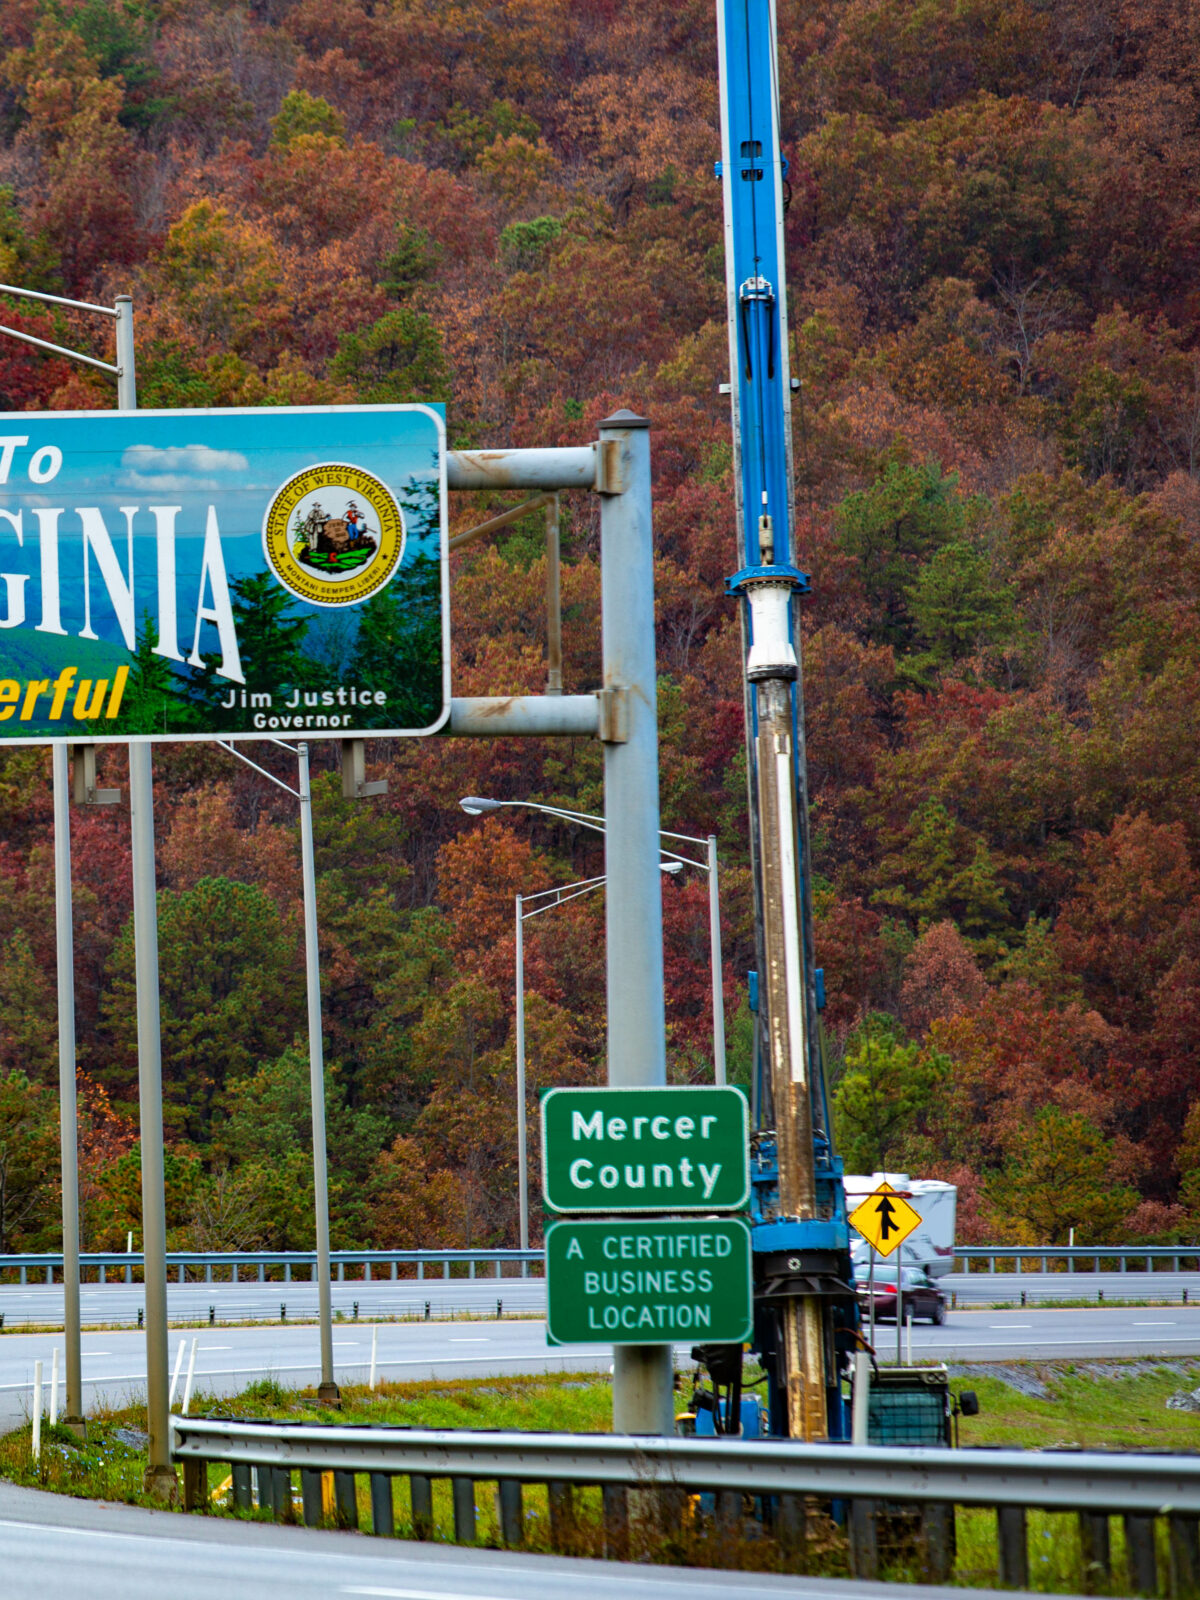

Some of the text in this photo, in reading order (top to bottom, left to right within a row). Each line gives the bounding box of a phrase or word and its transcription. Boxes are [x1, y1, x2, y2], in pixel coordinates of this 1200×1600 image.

[274, 495, 295, 536] STATE
[294, 481, 310, 497] OF
[312, 473, 352, 486] WEST
[352, 478, 394, 533] VIRGINIA
[286, 564, 381, 594] MONTANI SEMPER LIBERI
[221, 686, 387, 709] Jim Justice
[253, 712, 351, 729] Governor
[571, 1110, 719, 1141] Mercer
[568, 1157, 722, 1200] County
[566, 1235, 732, 1260] A CERTIFIED
[584, 1270, 713, 1295] BUSINESS
[588, 1305, 711, 1329] LOCATION
